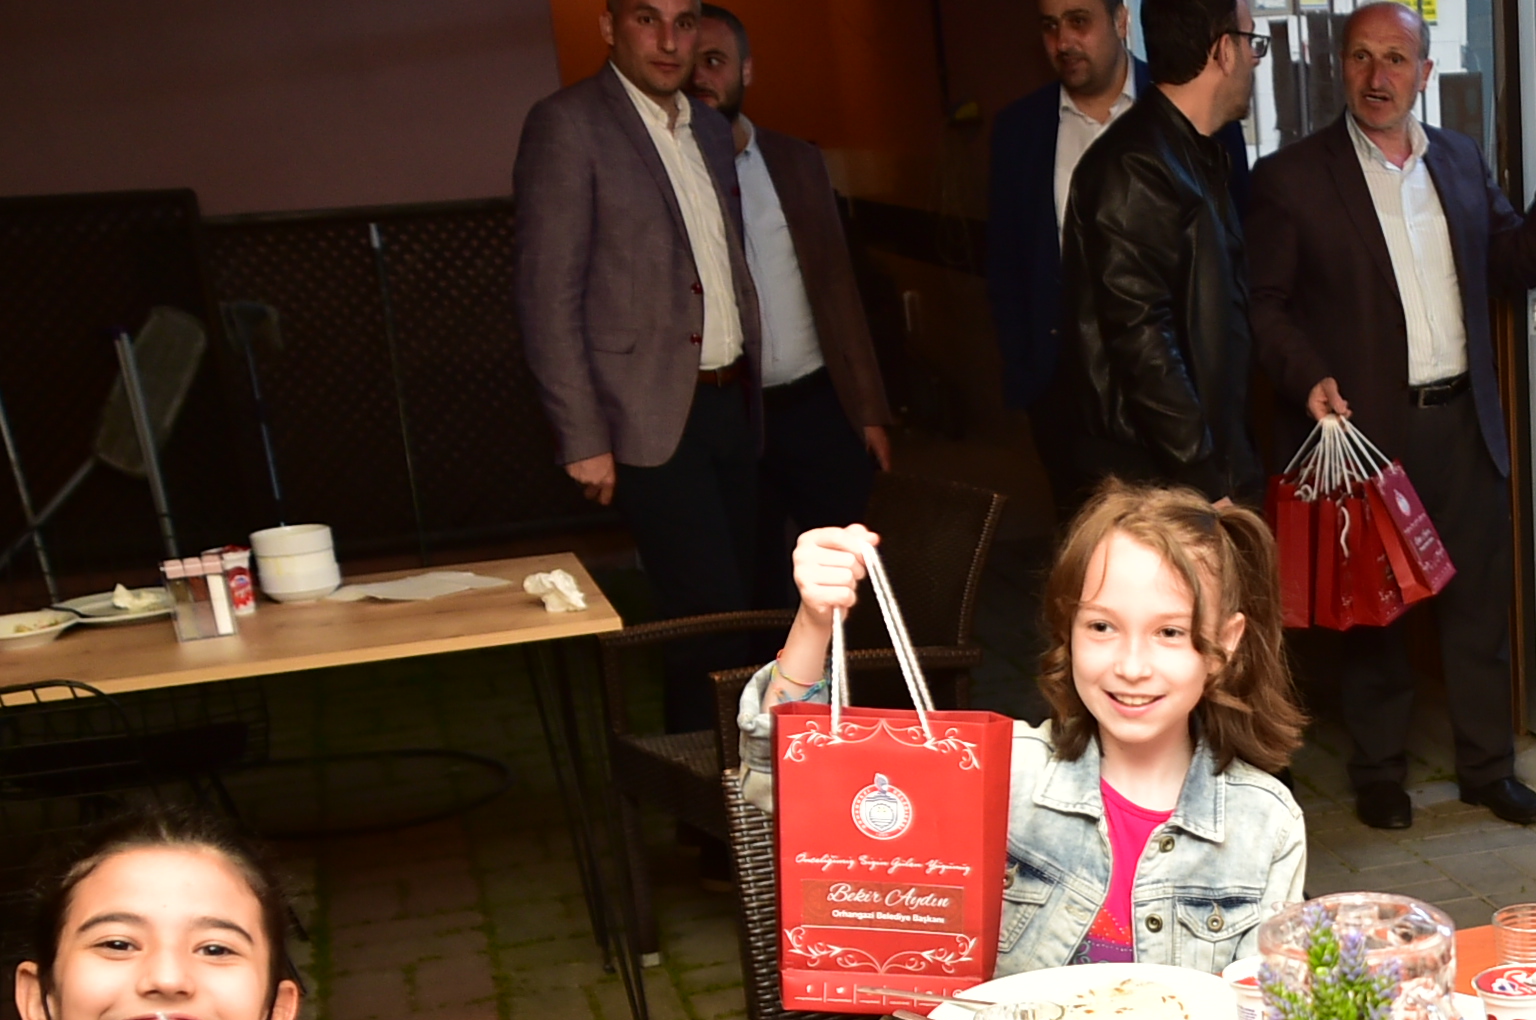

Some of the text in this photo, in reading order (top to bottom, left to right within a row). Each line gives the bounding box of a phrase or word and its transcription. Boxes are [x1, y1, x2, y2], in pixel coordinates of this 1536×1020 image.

[827, 882, 950, 910] Bekir Aydın
[832, 909, 945, 924] Orhangazi Belediye Başkanı
